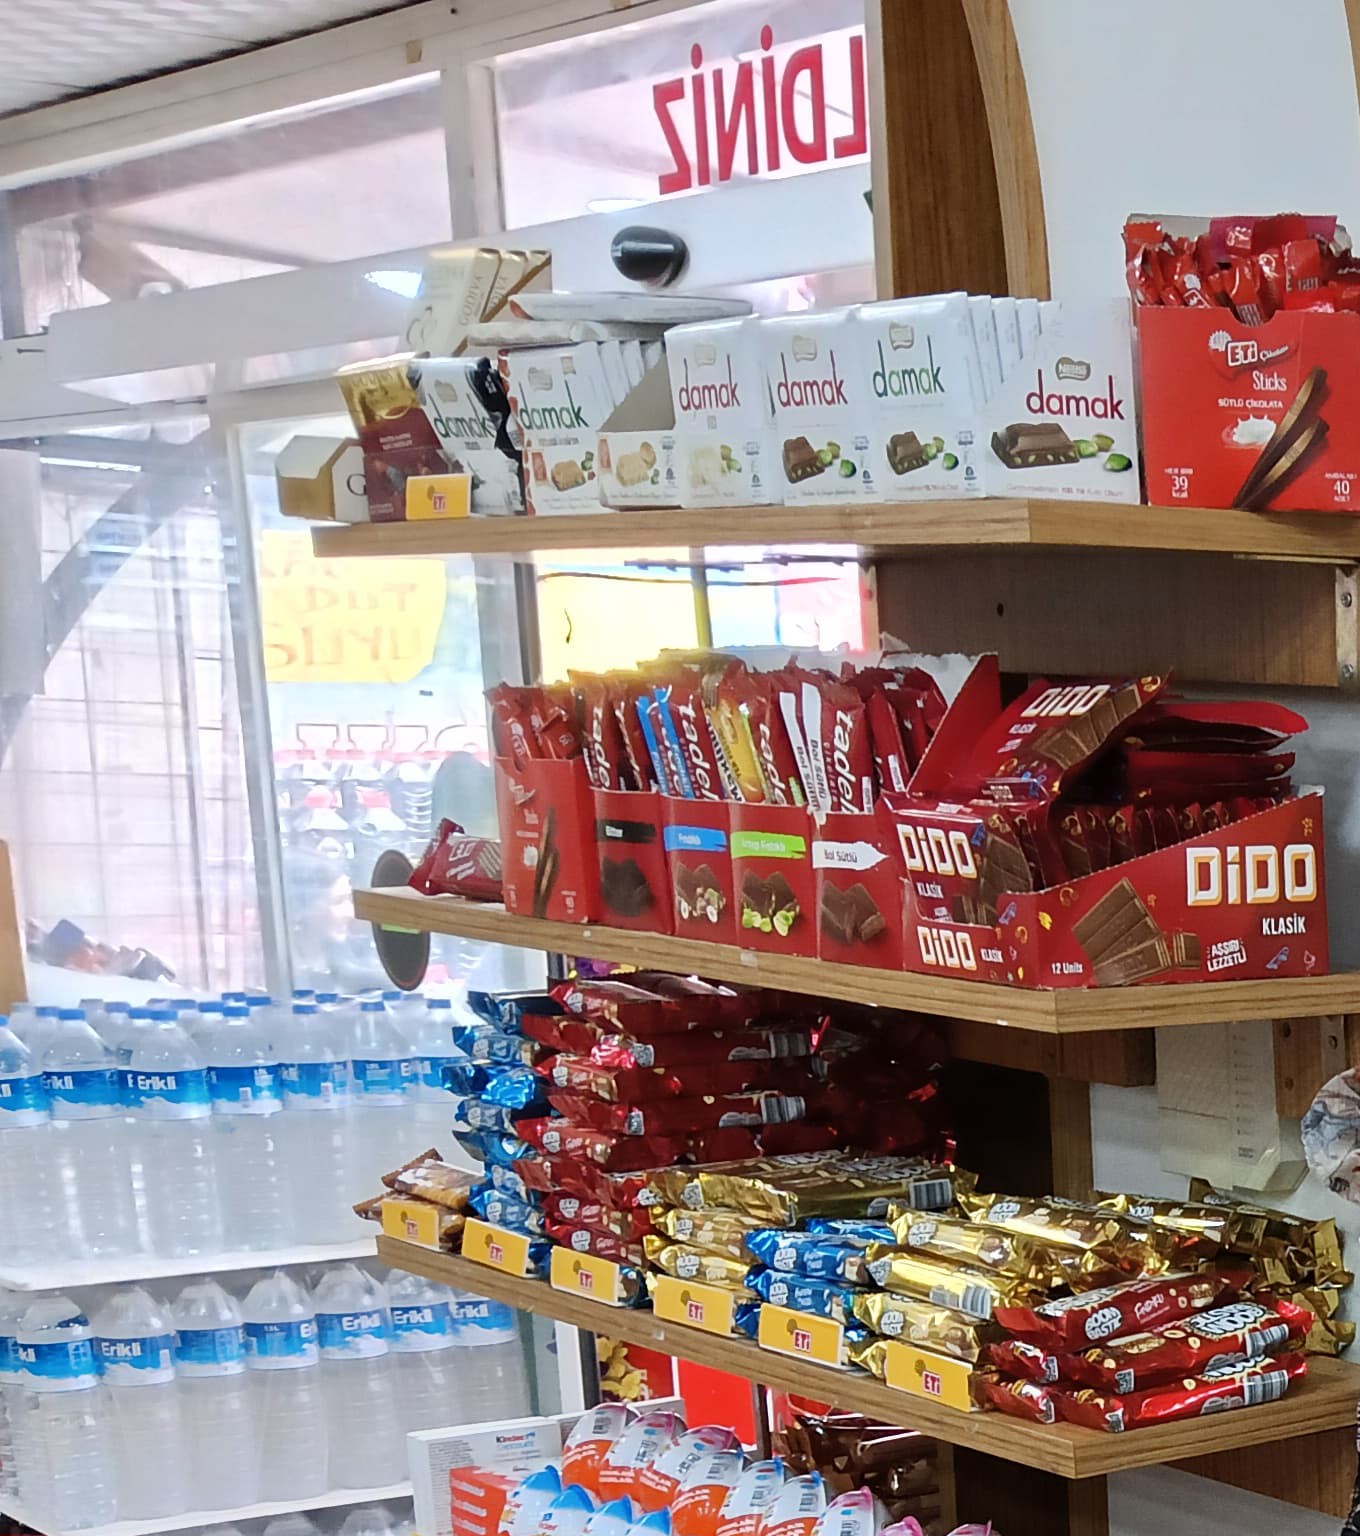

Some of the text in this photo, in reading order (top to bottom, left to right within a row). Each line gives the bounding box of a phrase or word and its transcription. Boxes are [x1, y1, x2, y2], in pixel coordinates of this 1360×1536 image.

[873, 335, 945, 398] damak
[679, 353, 741, 411] damak
[777, 349, 849, 408] damak
[1252, 371, 1287, 392] Sticks
[1026, 368, 1125, 420] damak
[426, 392, 497, 439] damak
[518, 380, 590, 431] damak
[1172, 476, 1189, 490] 39
[1333, 481, 1350, 494] 40
[916, 881, 944, 901] KLASİK
[1262, 912, 1306, 936] KLASİK
[980, 946, 1005, 963] KLASİK
[1051, 961, 1084, 975] 12 Units
[136, 1074, 177, 1091] Erikli
[341, 1313, 381, 1331] Erikli
[393, 1308, 434, 1326] Erikli
[101, 1341, 142, 1358] Erikli
